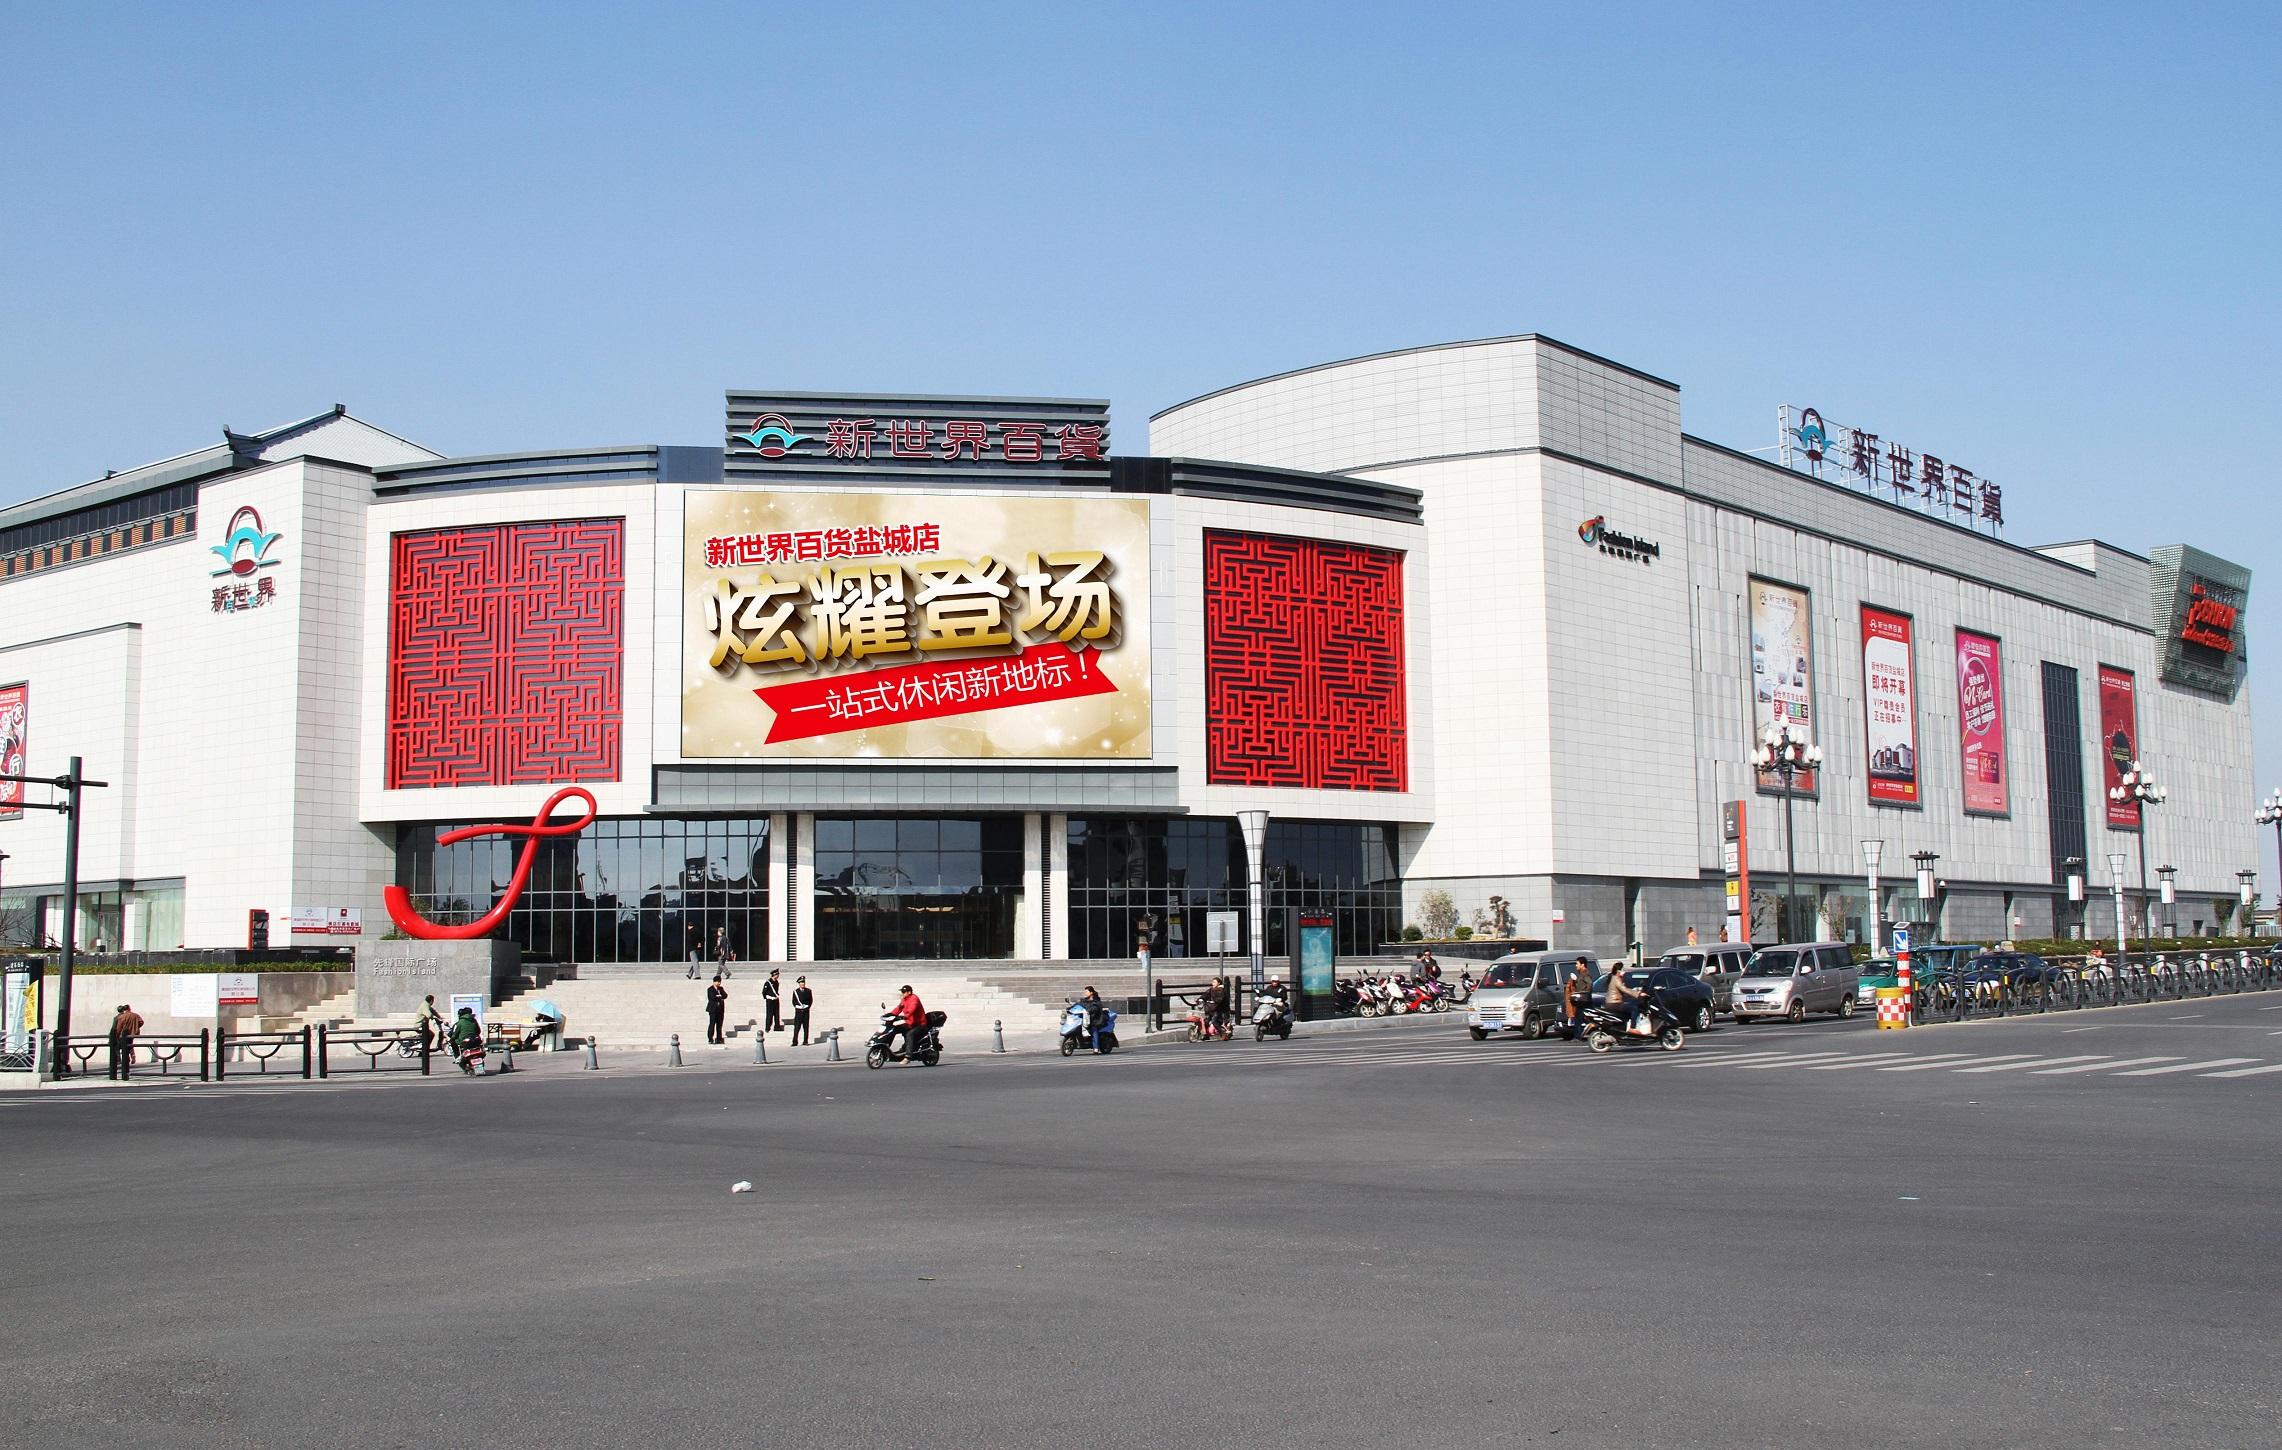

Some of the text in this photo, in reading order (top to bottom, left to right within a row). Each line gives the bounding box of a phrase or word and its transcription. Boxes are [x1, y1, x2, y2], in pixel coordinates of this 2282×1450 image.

[826, 417, 1104, 462] 新世界百貨
[1851, 427, 2004, 525] 新世界百貨
[705, 522, 941, 567] 新世界百货盐城店
[211, 576, 277, 614] 新世界
[703, 550, 1118, 668] 炫耀登场
[790, 653, 1089, 720] 一站式休闲新地标！
[1872, 674, 1906, 696] 即将开幕
